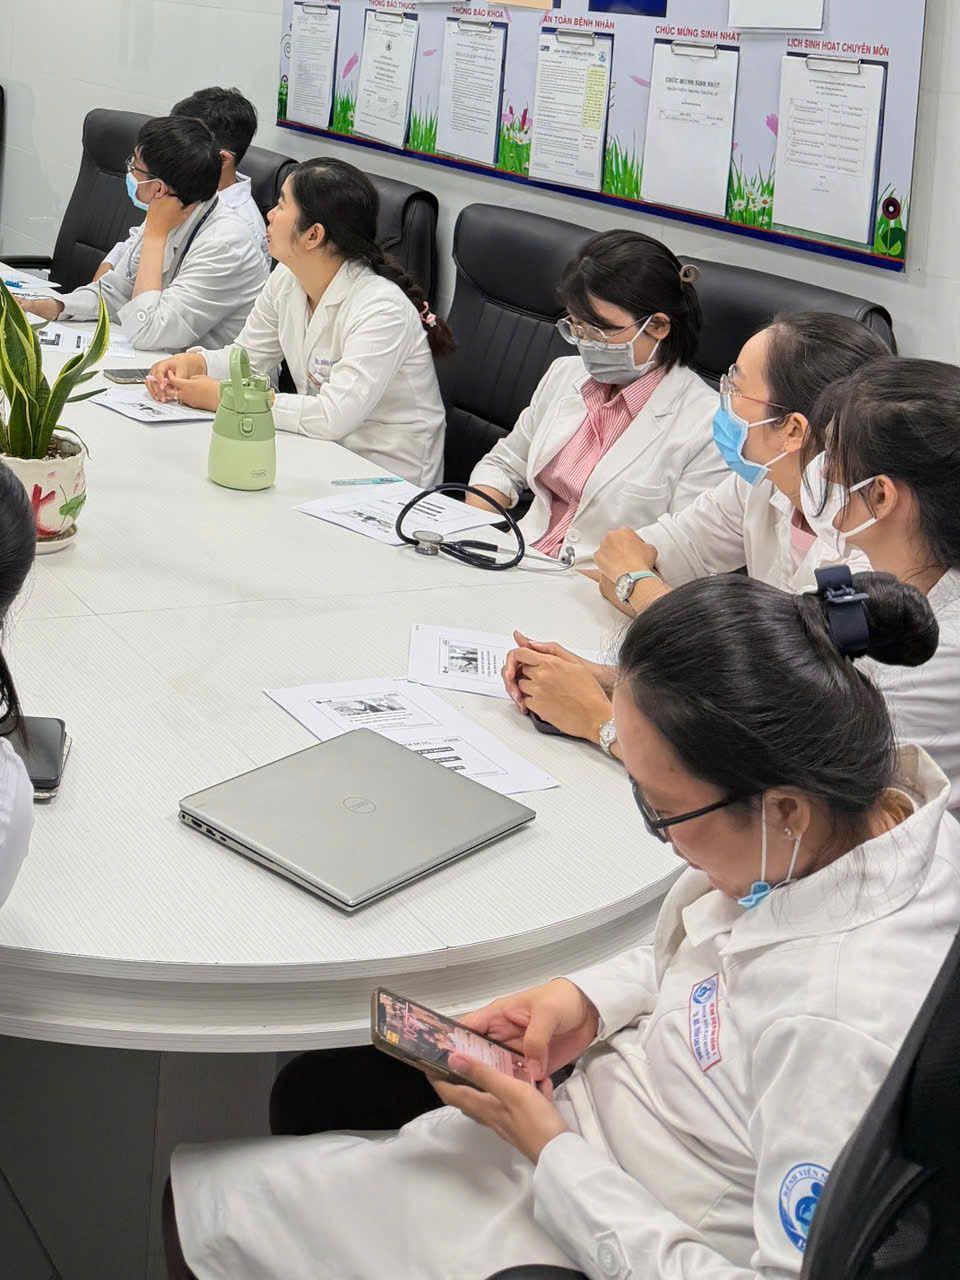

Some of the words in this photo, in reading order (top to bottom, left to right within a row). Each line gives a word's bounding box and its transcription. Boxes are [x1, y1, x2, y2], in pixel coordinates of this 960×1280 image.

[452, 6, 472, 16] THÔNG
[473, 8, 486, 17] BÁO
[487, 9, 504, 18] KHOA
[543, 15, 553, 23] AN
[554, 15, 572, 25] TOÀN
[574, 17, 593, 27] BỆNH
[594, 19, 615, 29] NHÂN
[655, 24, 675, 36] CHÚC
[677, 26, 699, 38] MỪNG
[700, 29, 718, 40] SINH
[719, 30, 741, 42] NHẬT
[787, 38, 803, 48] LỊCH
[804, 39, 820, 50] SINH
[822, 41, 840, 54] HOẠT
[842, 41, 871, 55] CHUYÊN
[873, 44, 889, 57] MÔN
